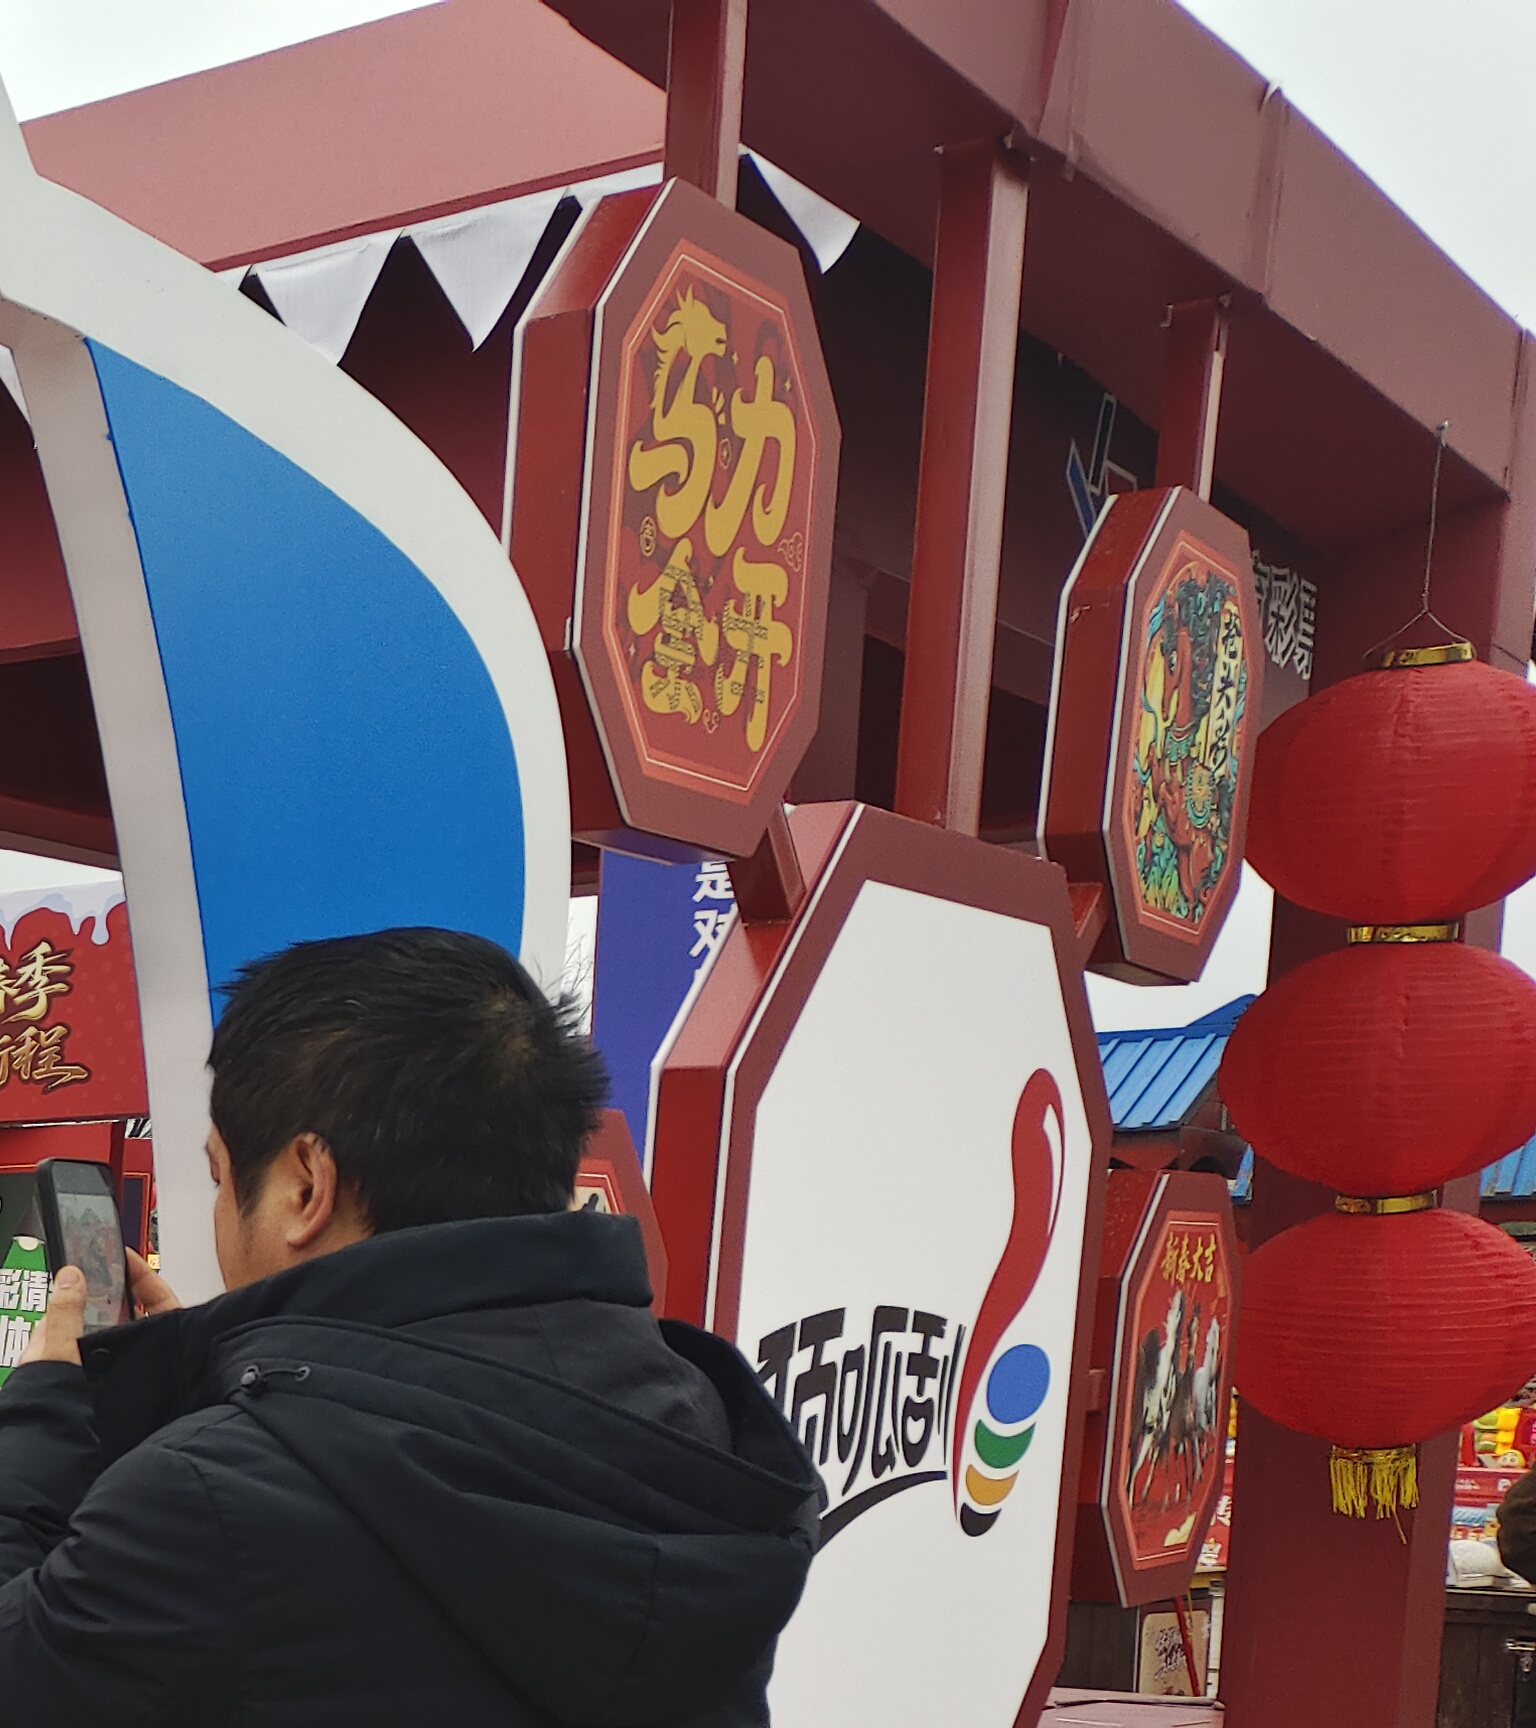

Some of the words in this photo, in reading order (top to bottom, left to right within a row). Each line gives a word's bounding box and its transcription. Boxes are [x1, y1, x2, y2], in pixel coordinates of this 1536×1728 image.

[627, 539, 794, 752] 全开
[1160, 1231, 1217, 1286] 新春大吉
